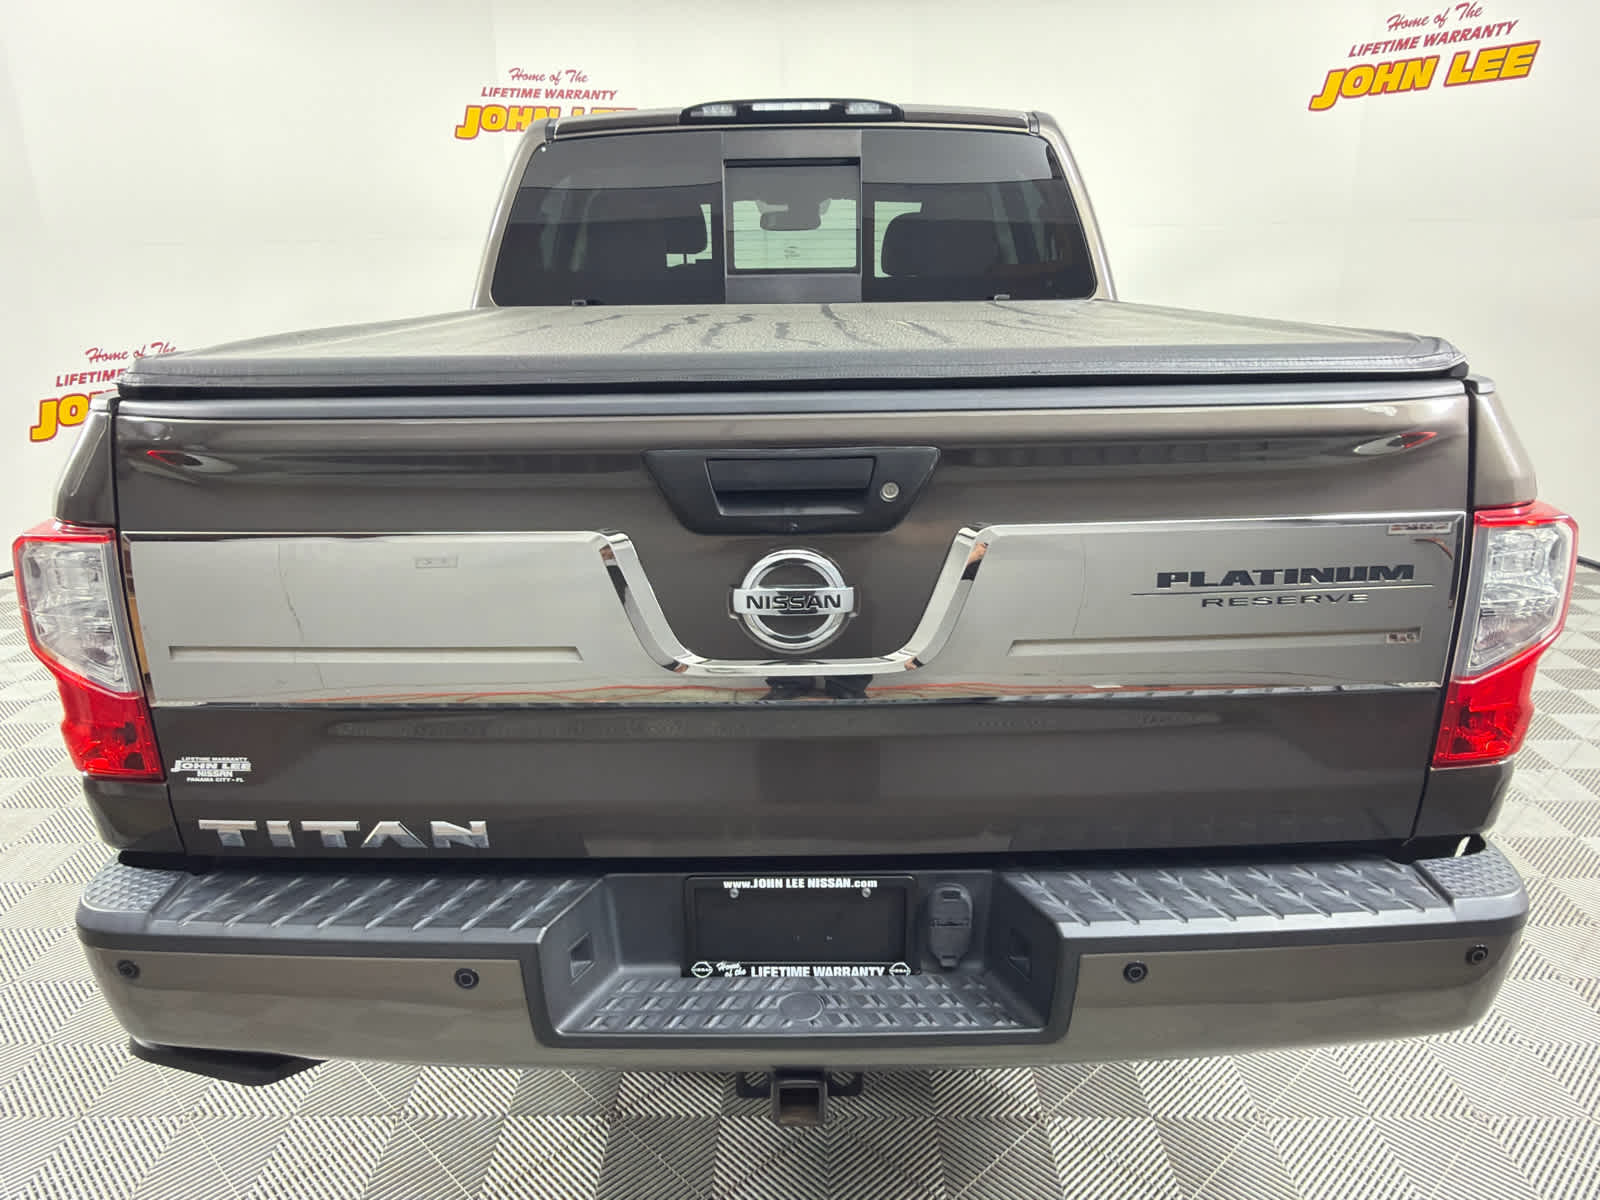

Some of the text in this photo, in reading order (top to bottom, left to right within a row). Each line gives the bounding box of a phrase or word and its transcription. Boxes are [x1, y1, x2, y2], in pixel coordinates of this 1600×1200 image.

[1387, 1, 1484, 32] Home of The
[1348, 20, 1519, 57] LIFETIME WARRANTY
[508, 67, 588, 85] Home of The
[1308, 40, 1541, 111] JOHN LEE
[480, 86, 617, 100] LIFETIME WARRANTY
[85, 347, 129, 363] Home
[1156, 564, 1415, 589] PLATINUM
[746, 594, 841, 609] NISSAN
[1201, 593, 1369, 608] RESERVE
[170, 760, 252, 772] JOHN LEE
[198, 819, 490, 848] TITAN
[723, 878, 878, 889] www.JOHN LEE NISSAN.com
[751, 966, 810, 977] LIFETIME
[812, 966, 885, 977] WARRANTY
